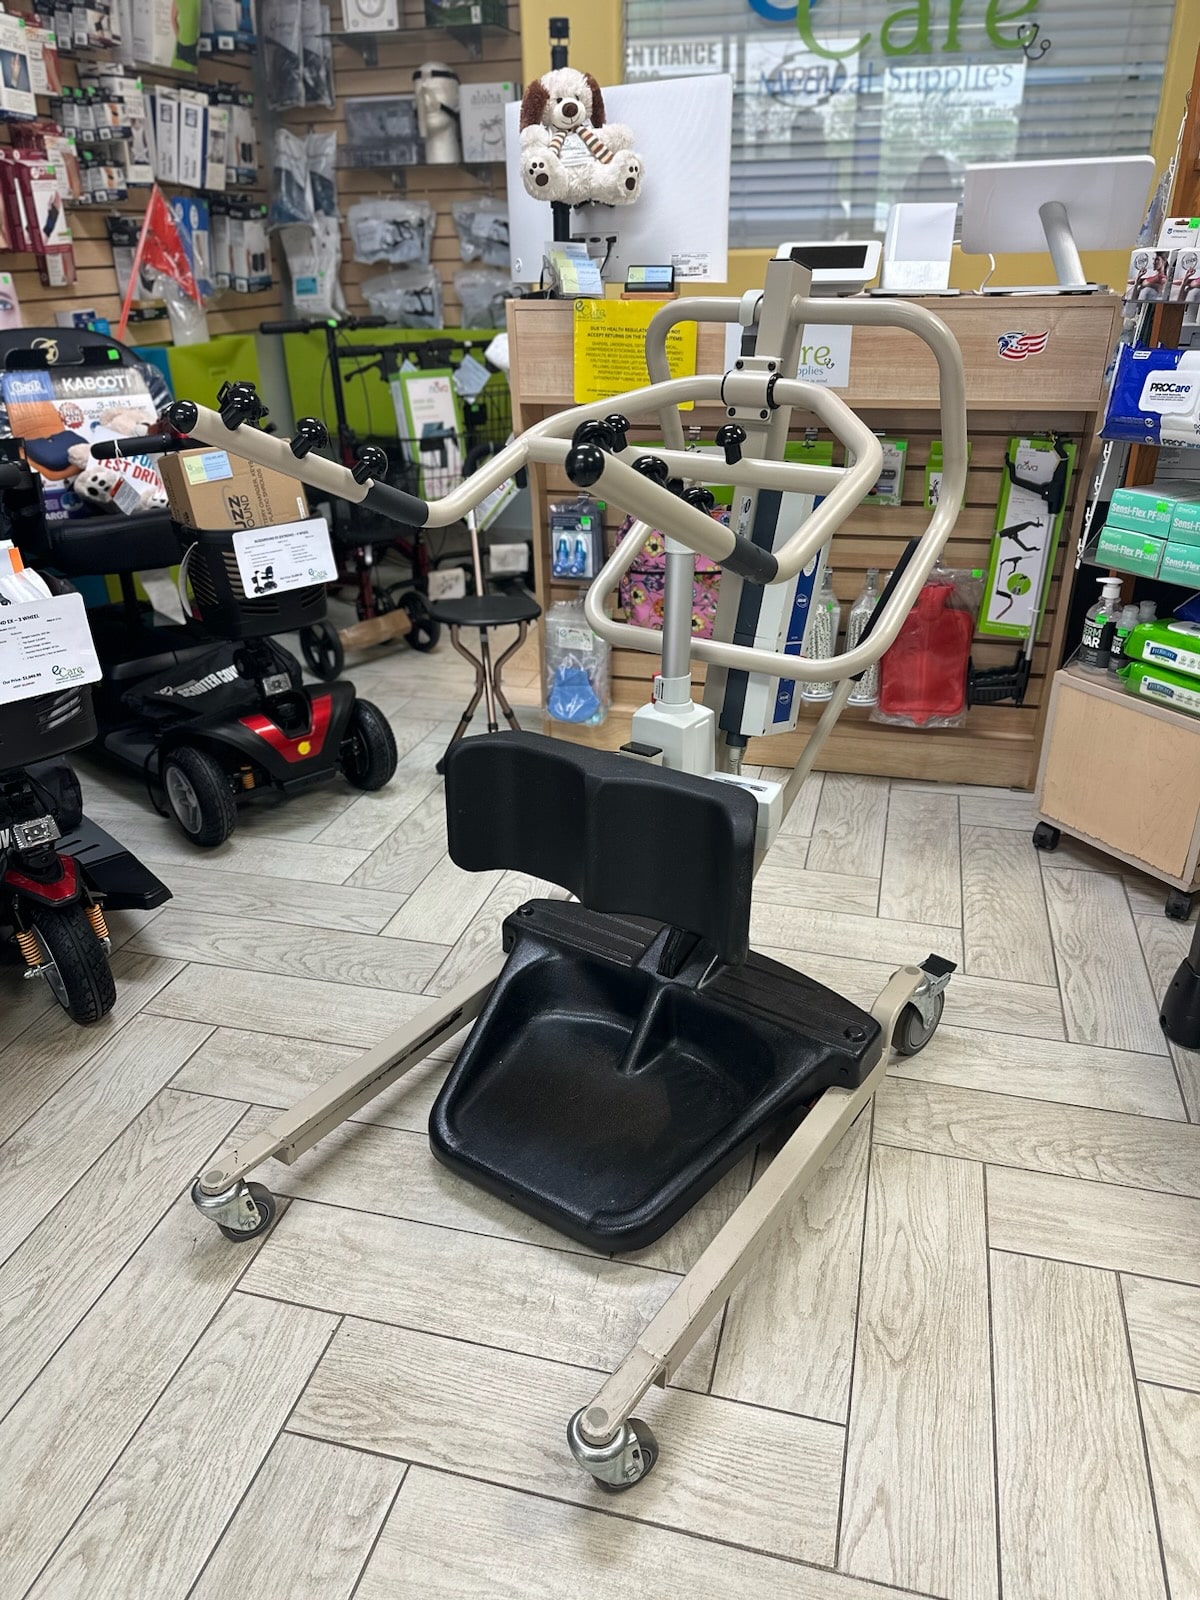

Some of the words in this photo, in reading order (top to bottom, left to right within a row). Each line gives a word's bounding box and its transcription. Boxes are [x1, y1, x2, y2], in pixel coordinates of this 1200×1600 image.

[747, 0, 1040, 59] Care
[626, 42, 718, 67] NTRANCE
[888, 57, 1014, 97] Supplies
[61, 374, 131, 393] KABOOTI
[1149, 382, 1190, 393] PROCare
[97, 456, 131, 473] TEST
[1016, 463, 1039, 472] nova
[45, 511, 69, 520] ARGE
[1111, 502, 1147, 518] Sensi-Flex
[1100, 540, 1134, 556] Sensi-Flex
[52, 665, 85, 678] eCare
